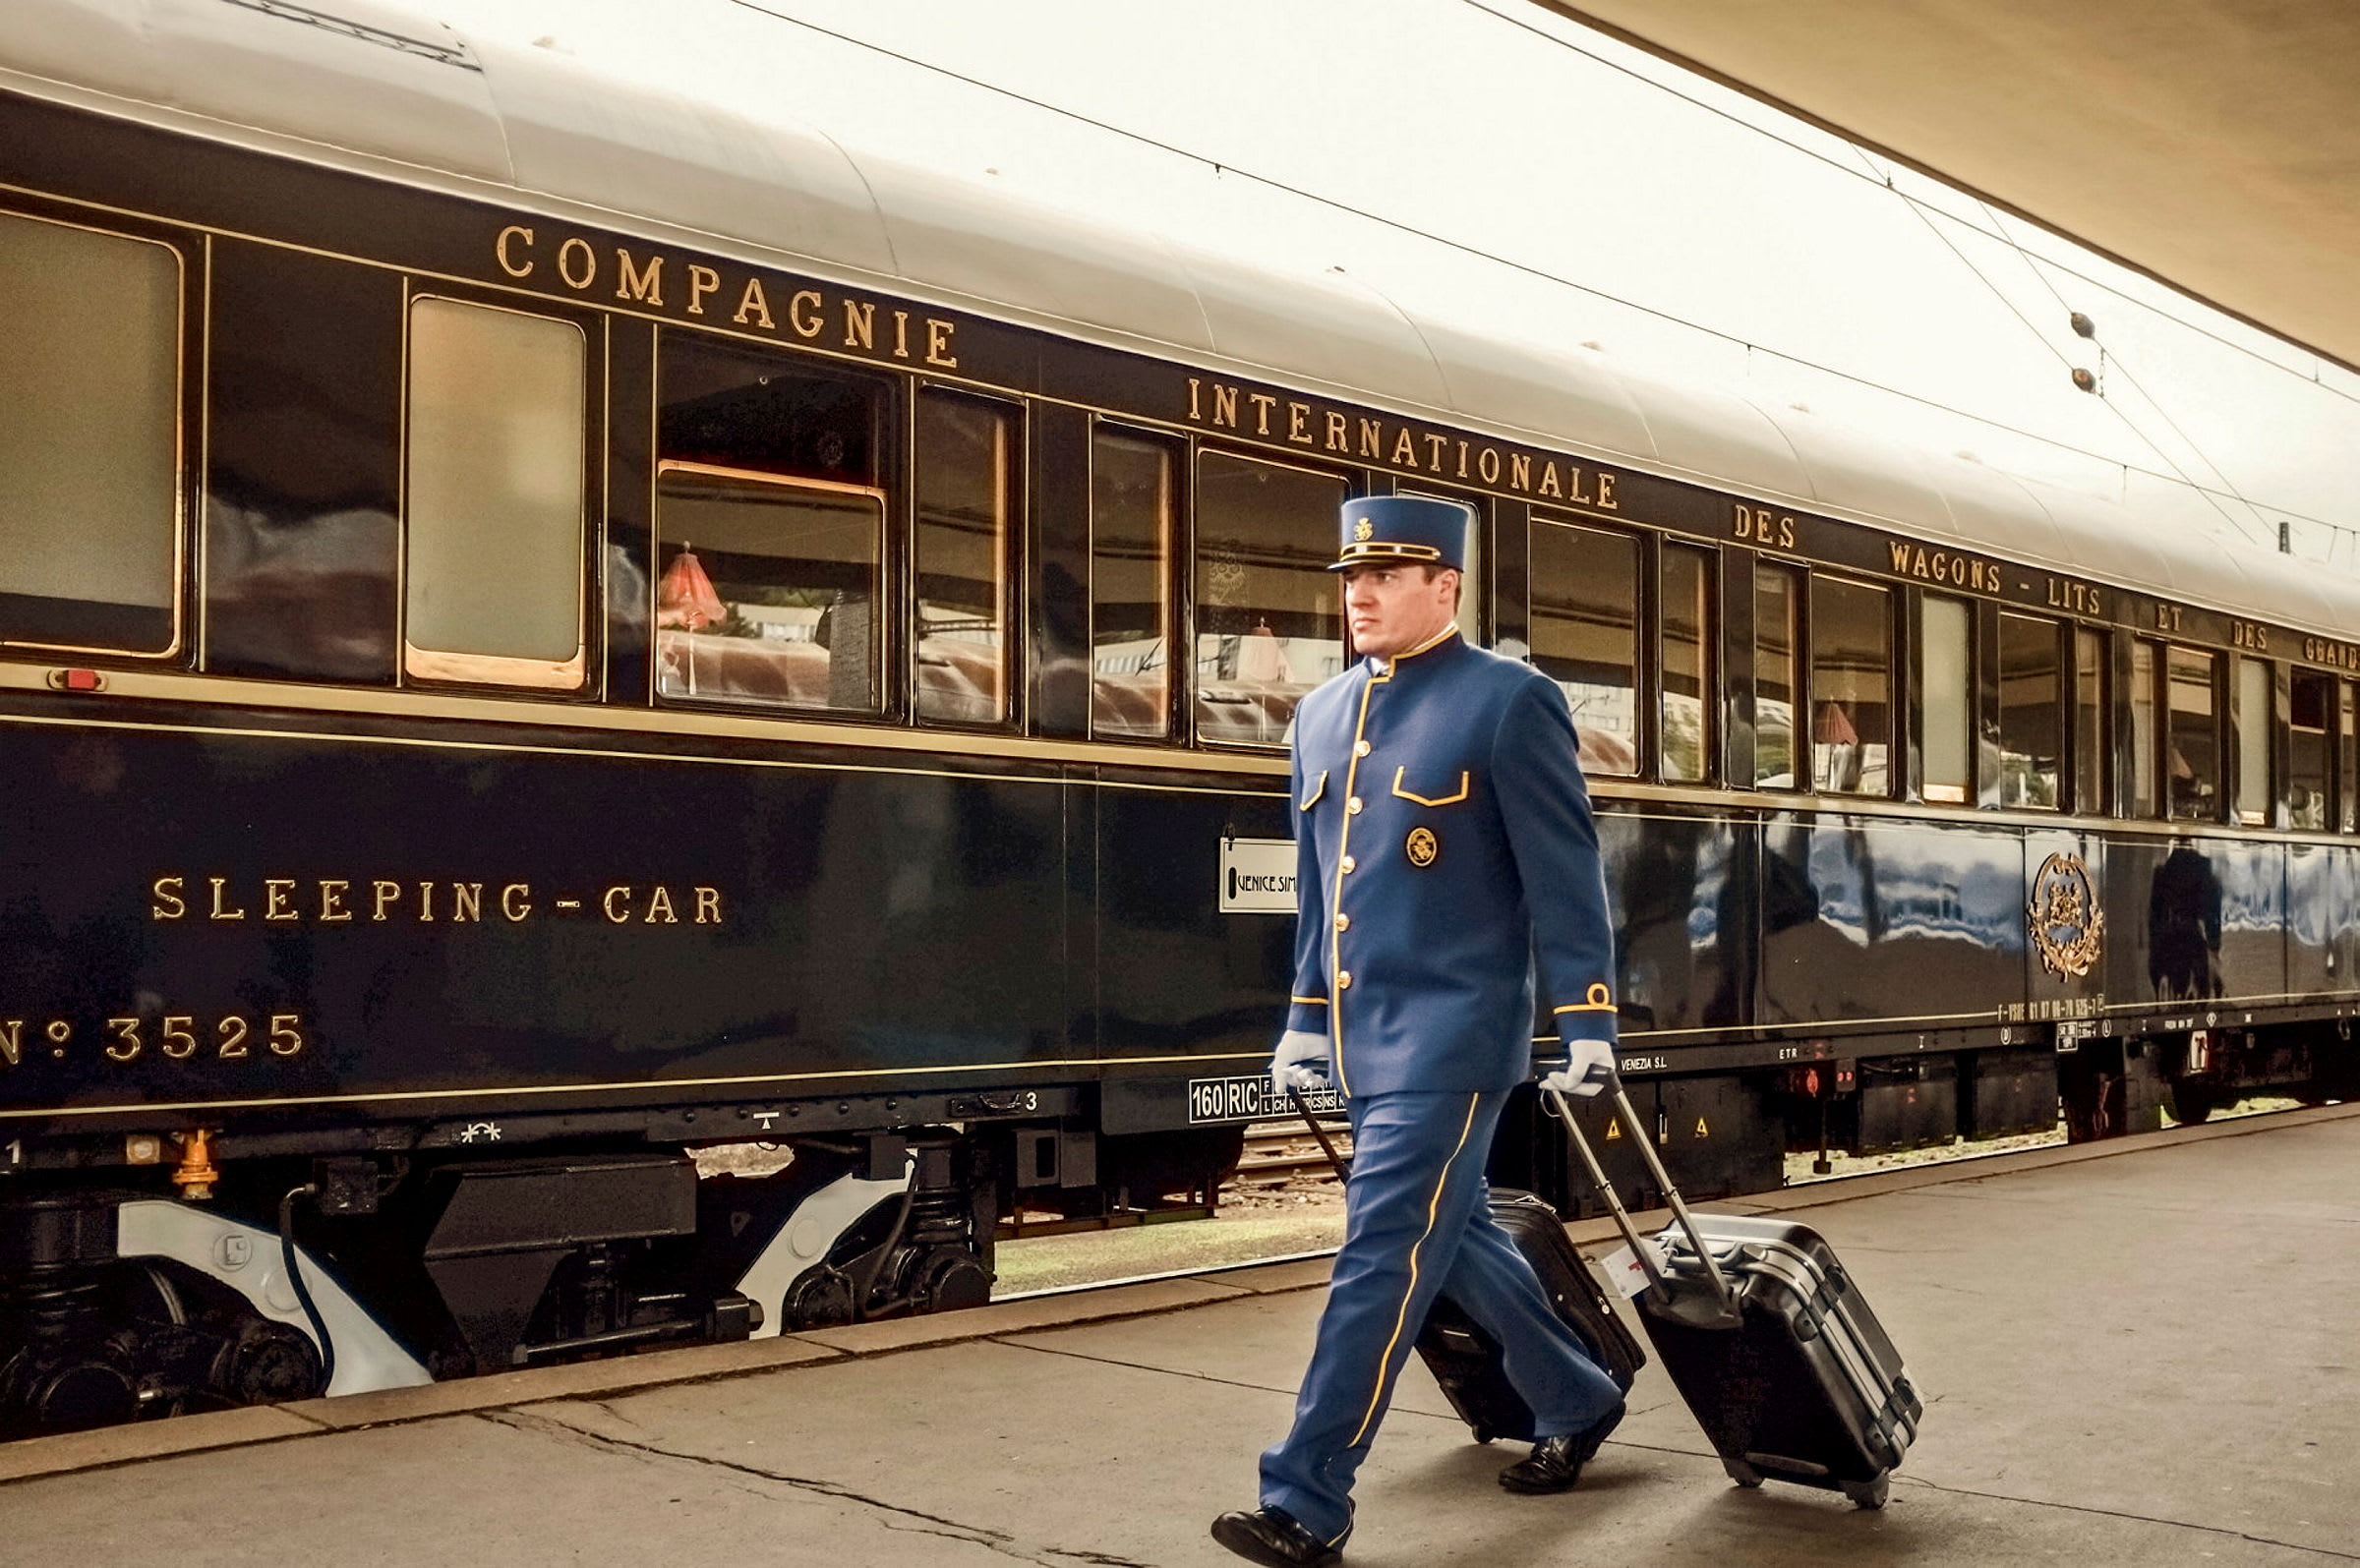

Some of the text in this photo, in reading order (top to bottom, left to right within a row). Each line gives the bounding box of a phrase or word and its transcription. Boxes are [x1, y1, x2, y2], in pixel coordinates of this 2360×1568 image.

[497, 226, 958, 369] COMPAGNIE
[1188, 377, 1619, 509] INTERNATIONALE
[1735, 504, 1797, 549] DES
[2047, 578, 2100, 614] LITS
[2157, 605, 2182, 632] ET
[2234, 621, 2267, 650] DES
[1238, 875, 1276, 892] VENICE
[106, 1015, 302, 1061] 3525
[1622, 1057, 1651, 1071] VENEZIA
[1265, 1080, 1269, 1092] F
[1026, 1091, 1037, 1111] 3
[1193, 1081, 1258, 1117] 160 RIC
[1265, 1100, 1269, 1112] L
[1274, 1099, 1285, 1111] CH
[1312, 1096, 1323, 1108] CS
[5, 1140, 21, 1164] 1
